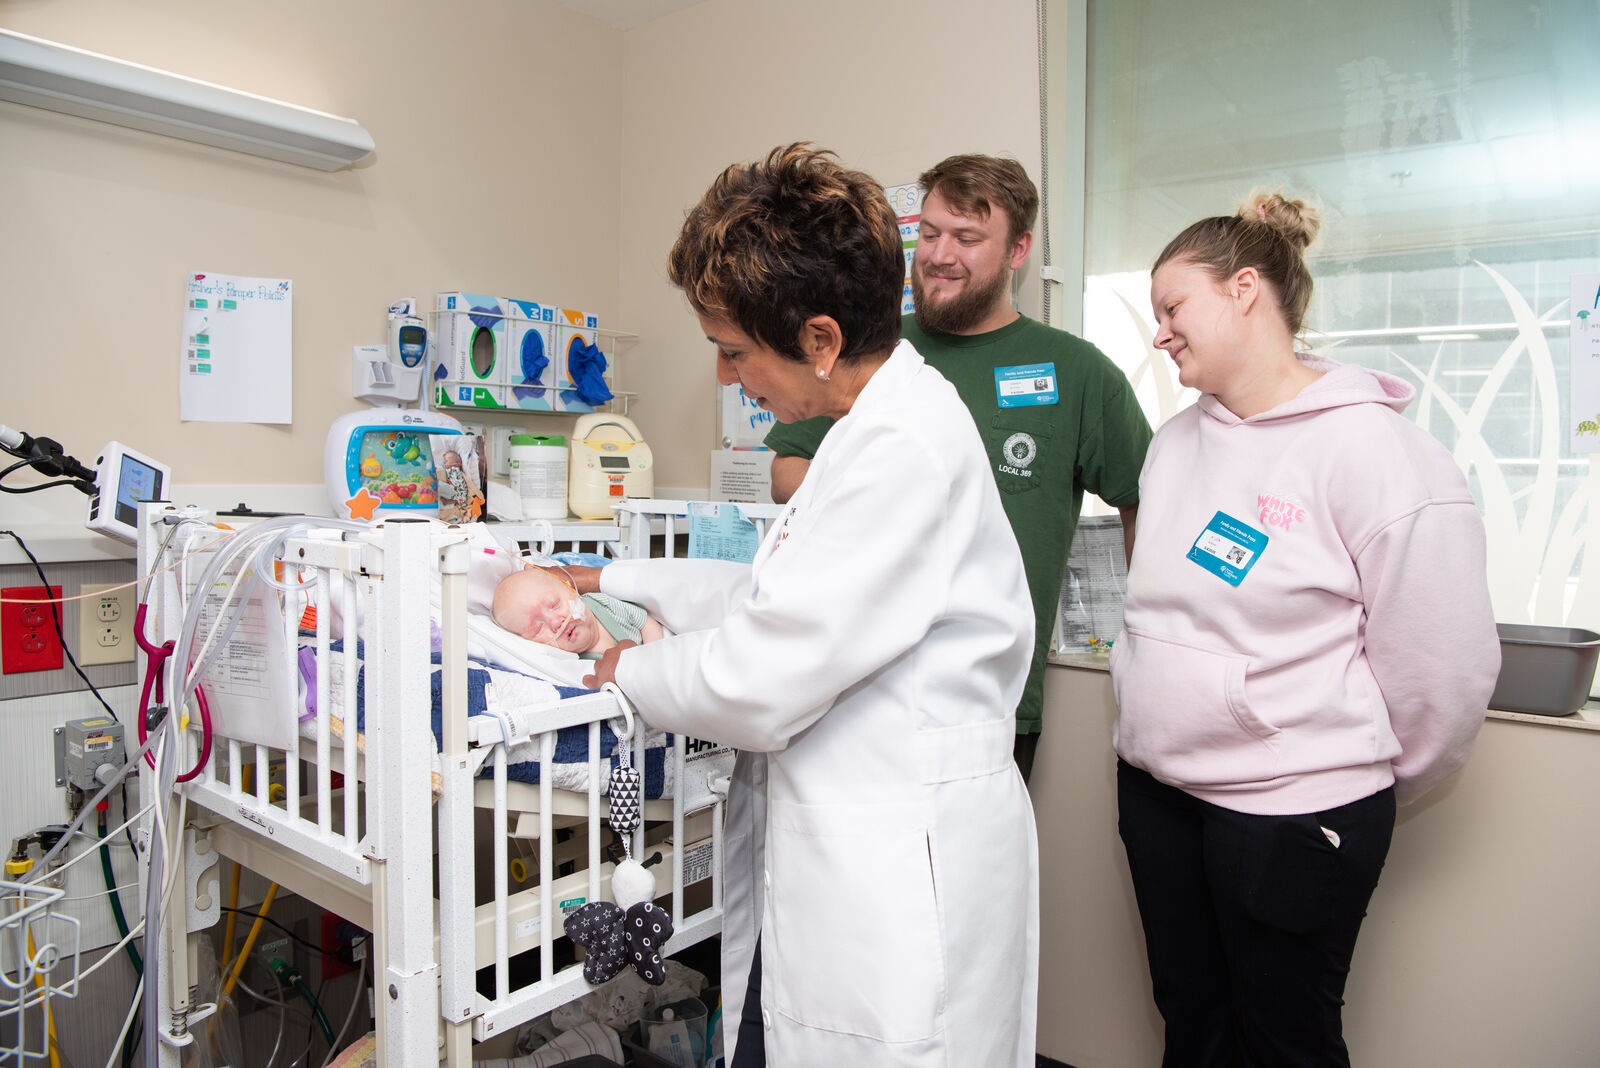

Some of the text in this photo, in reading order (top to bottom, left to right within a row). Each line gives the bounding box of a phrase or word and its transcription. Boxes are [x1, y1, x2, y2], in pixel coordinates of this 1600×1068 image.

[530, 307, 539, 318] M
[574, 317, 583, 325] S
[998, 464, 1019, 476] LOCAL
[1257, 495, 1305, 522] WHITE
[1260, 506, 1294, 532] FOX
[685, 749, 721, 763] MANUFACTURING
